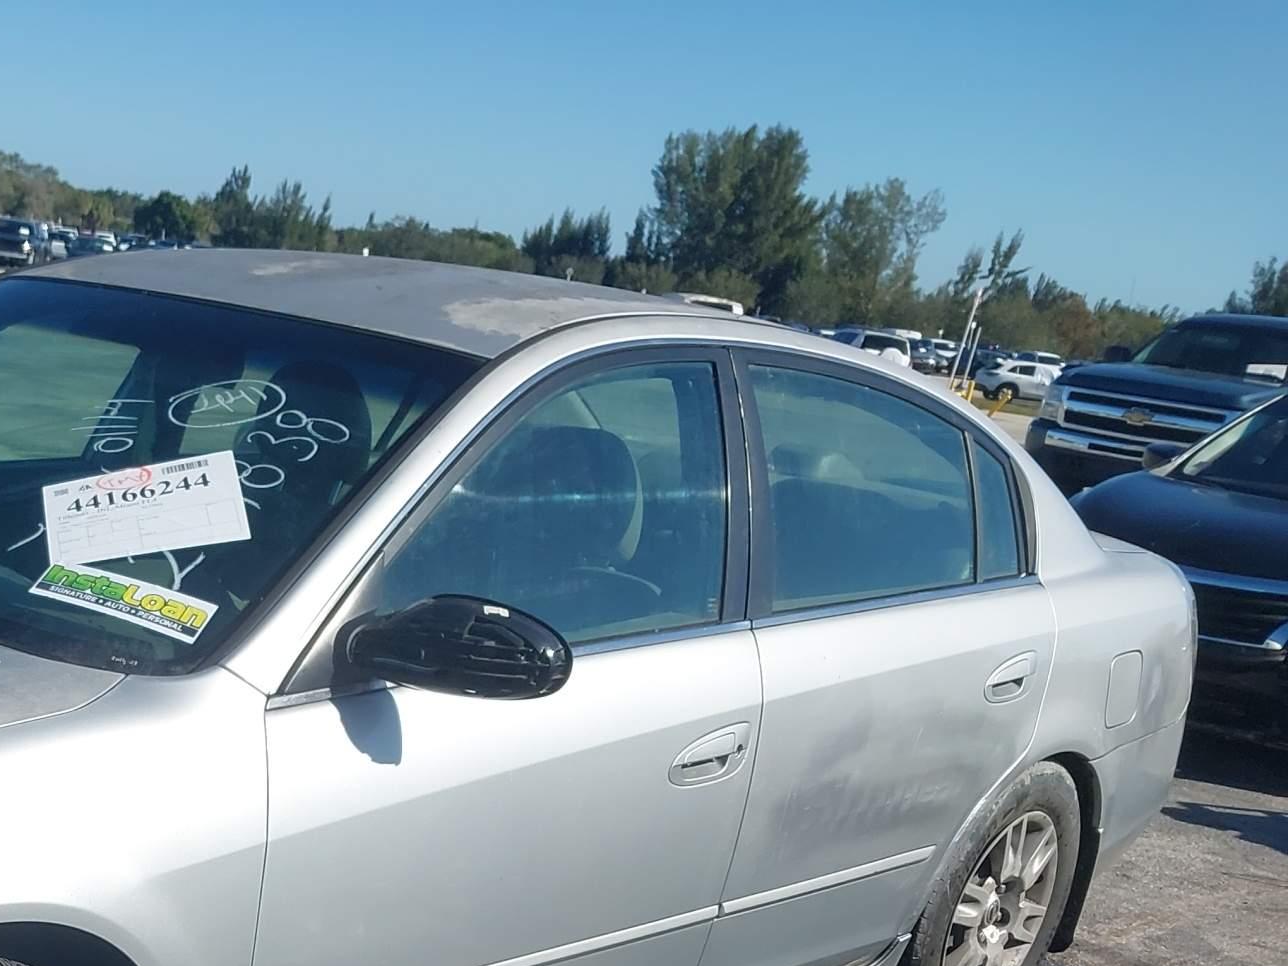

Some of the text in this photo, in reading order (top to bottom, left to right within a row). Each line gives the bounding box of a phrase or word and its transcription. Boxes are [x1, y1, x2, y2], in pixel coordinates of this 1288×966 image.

[66, 472, 212, 513] 44166244
[42, 564, 209, 630] InstaLoan
[49, 585, 184, 633] SIGNATURE AUTO PERSONAL
